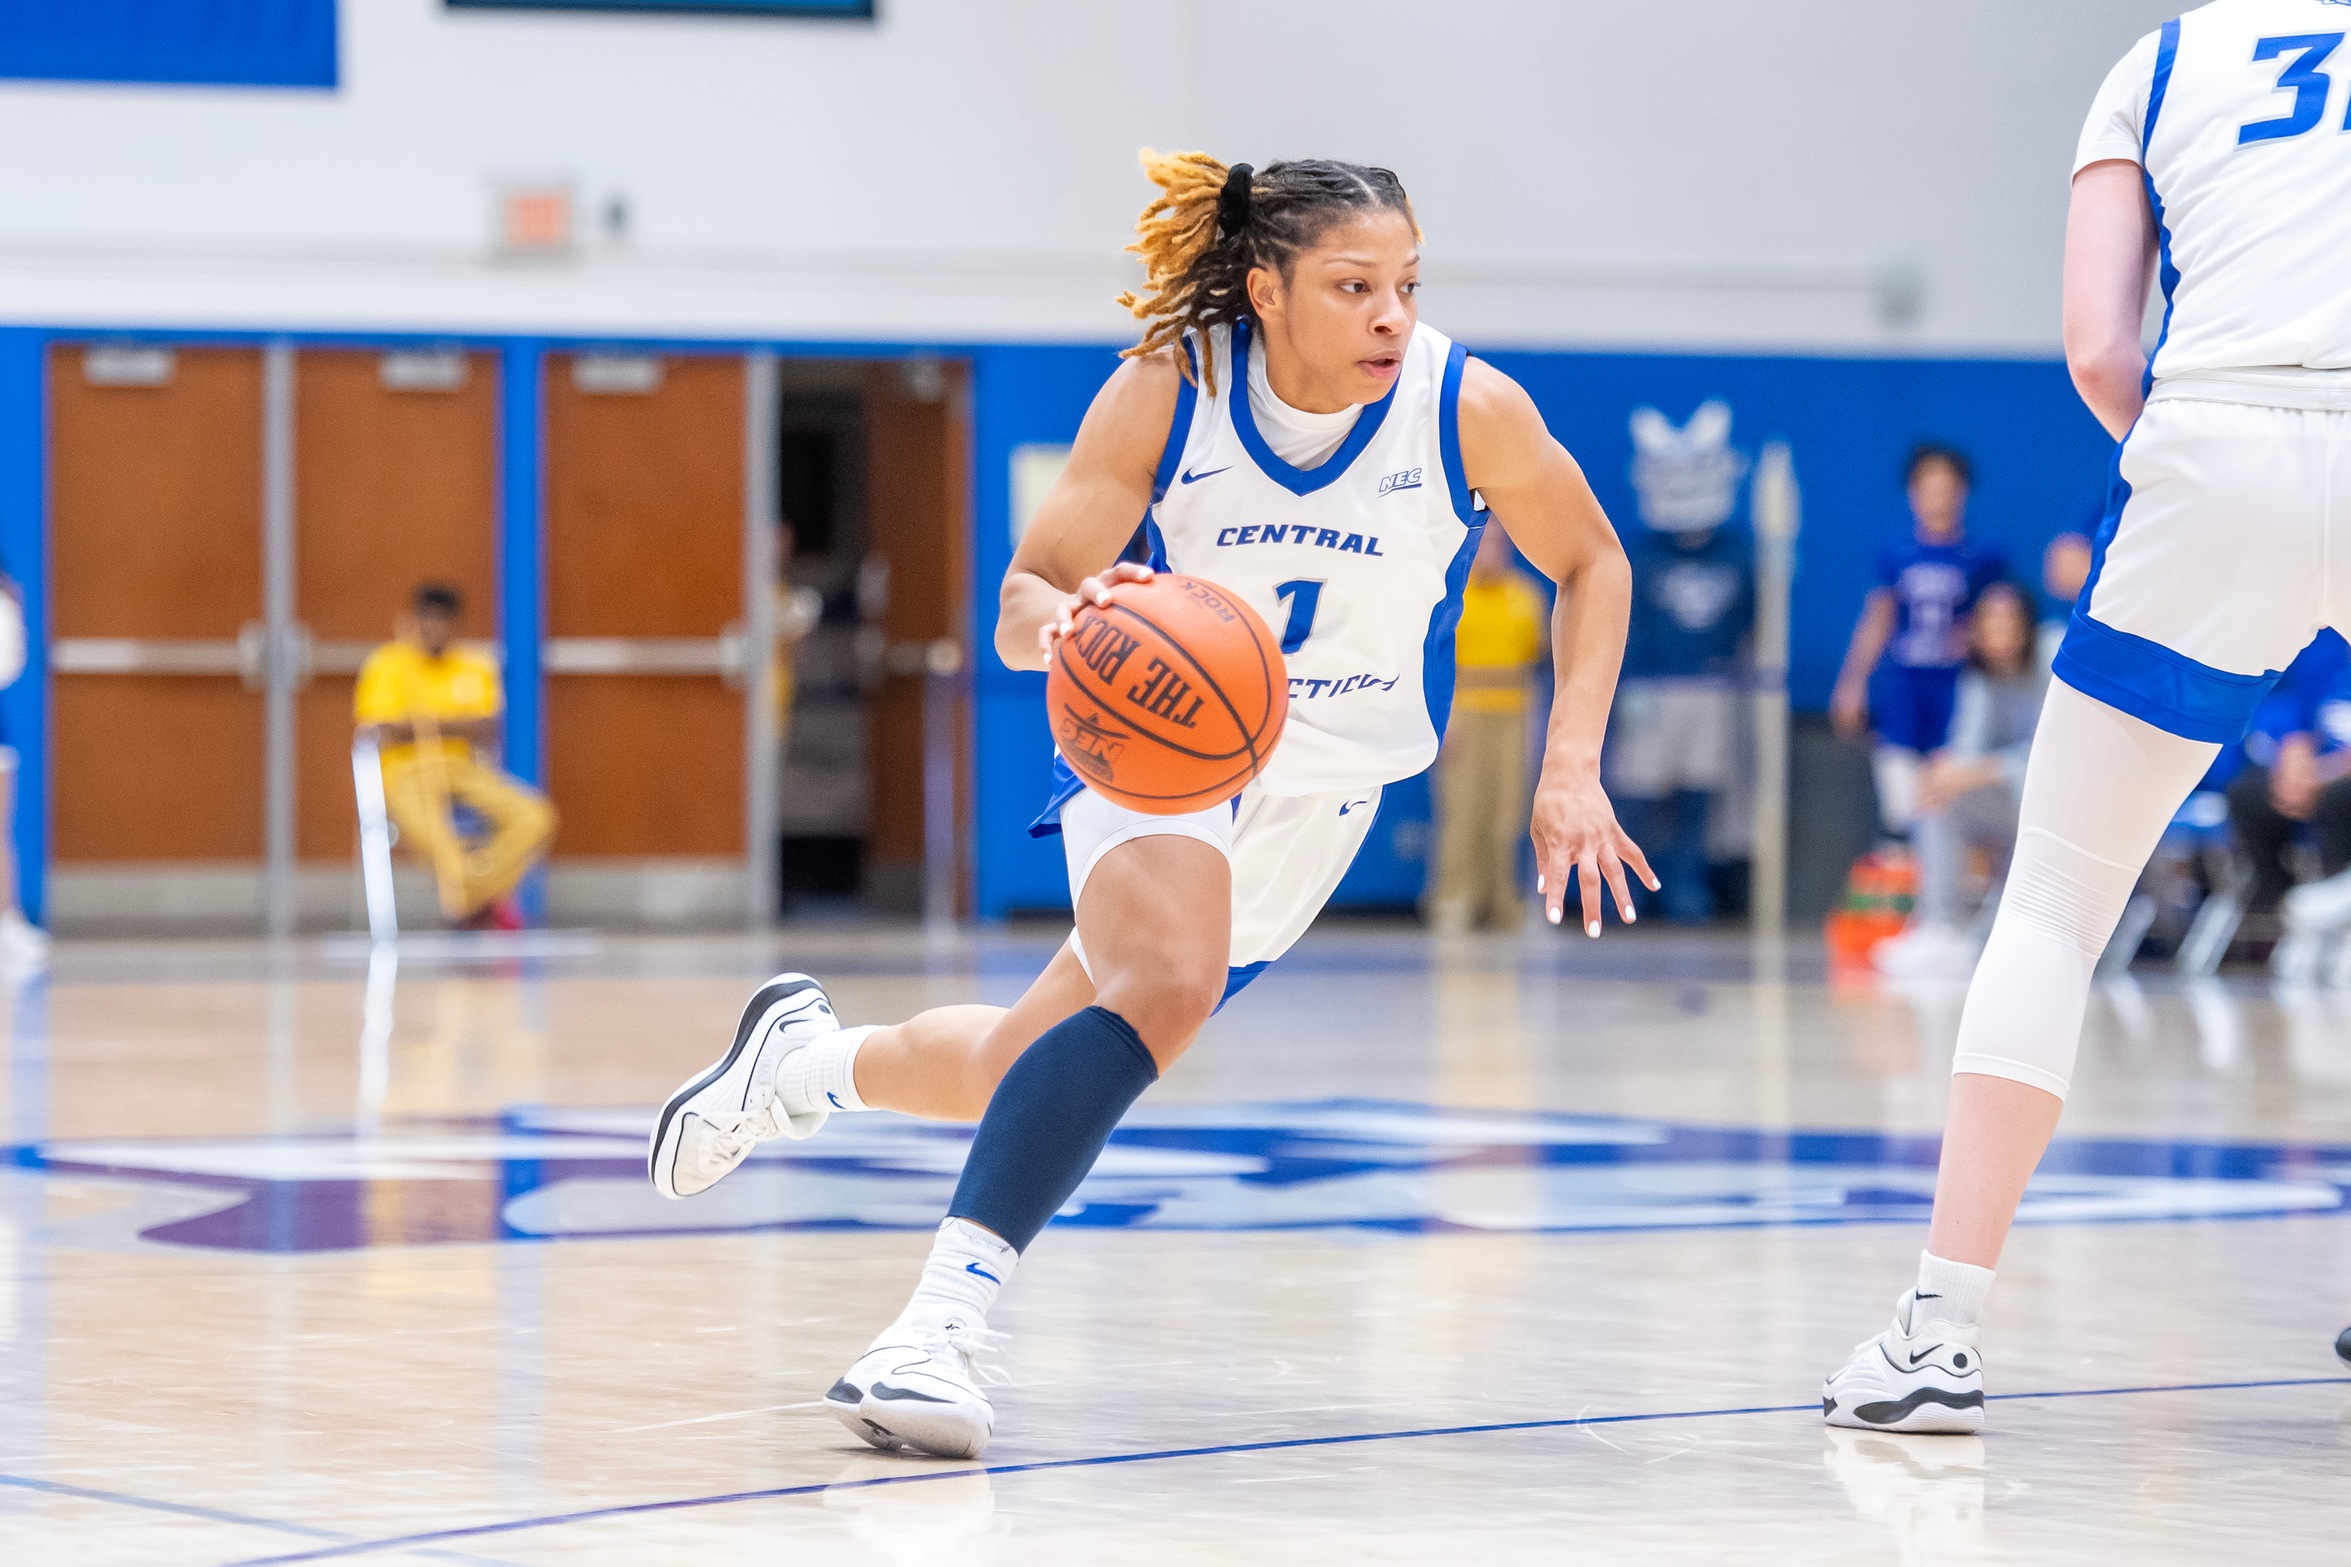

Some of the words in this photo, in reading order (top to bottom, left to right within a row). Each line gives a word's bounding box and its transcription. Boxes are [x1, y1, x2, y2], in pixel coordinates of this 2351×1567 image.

[2234, 29, 2351, 151] 3
[1378, 467, 1422, 493] NEC
[1216, 524, 1384, 557] CENTRAL
[1072, 613, 1141, 687] ROCK
[1272, 577, 1328, 656] 1
[1126, 657, 1205, 729] THE
